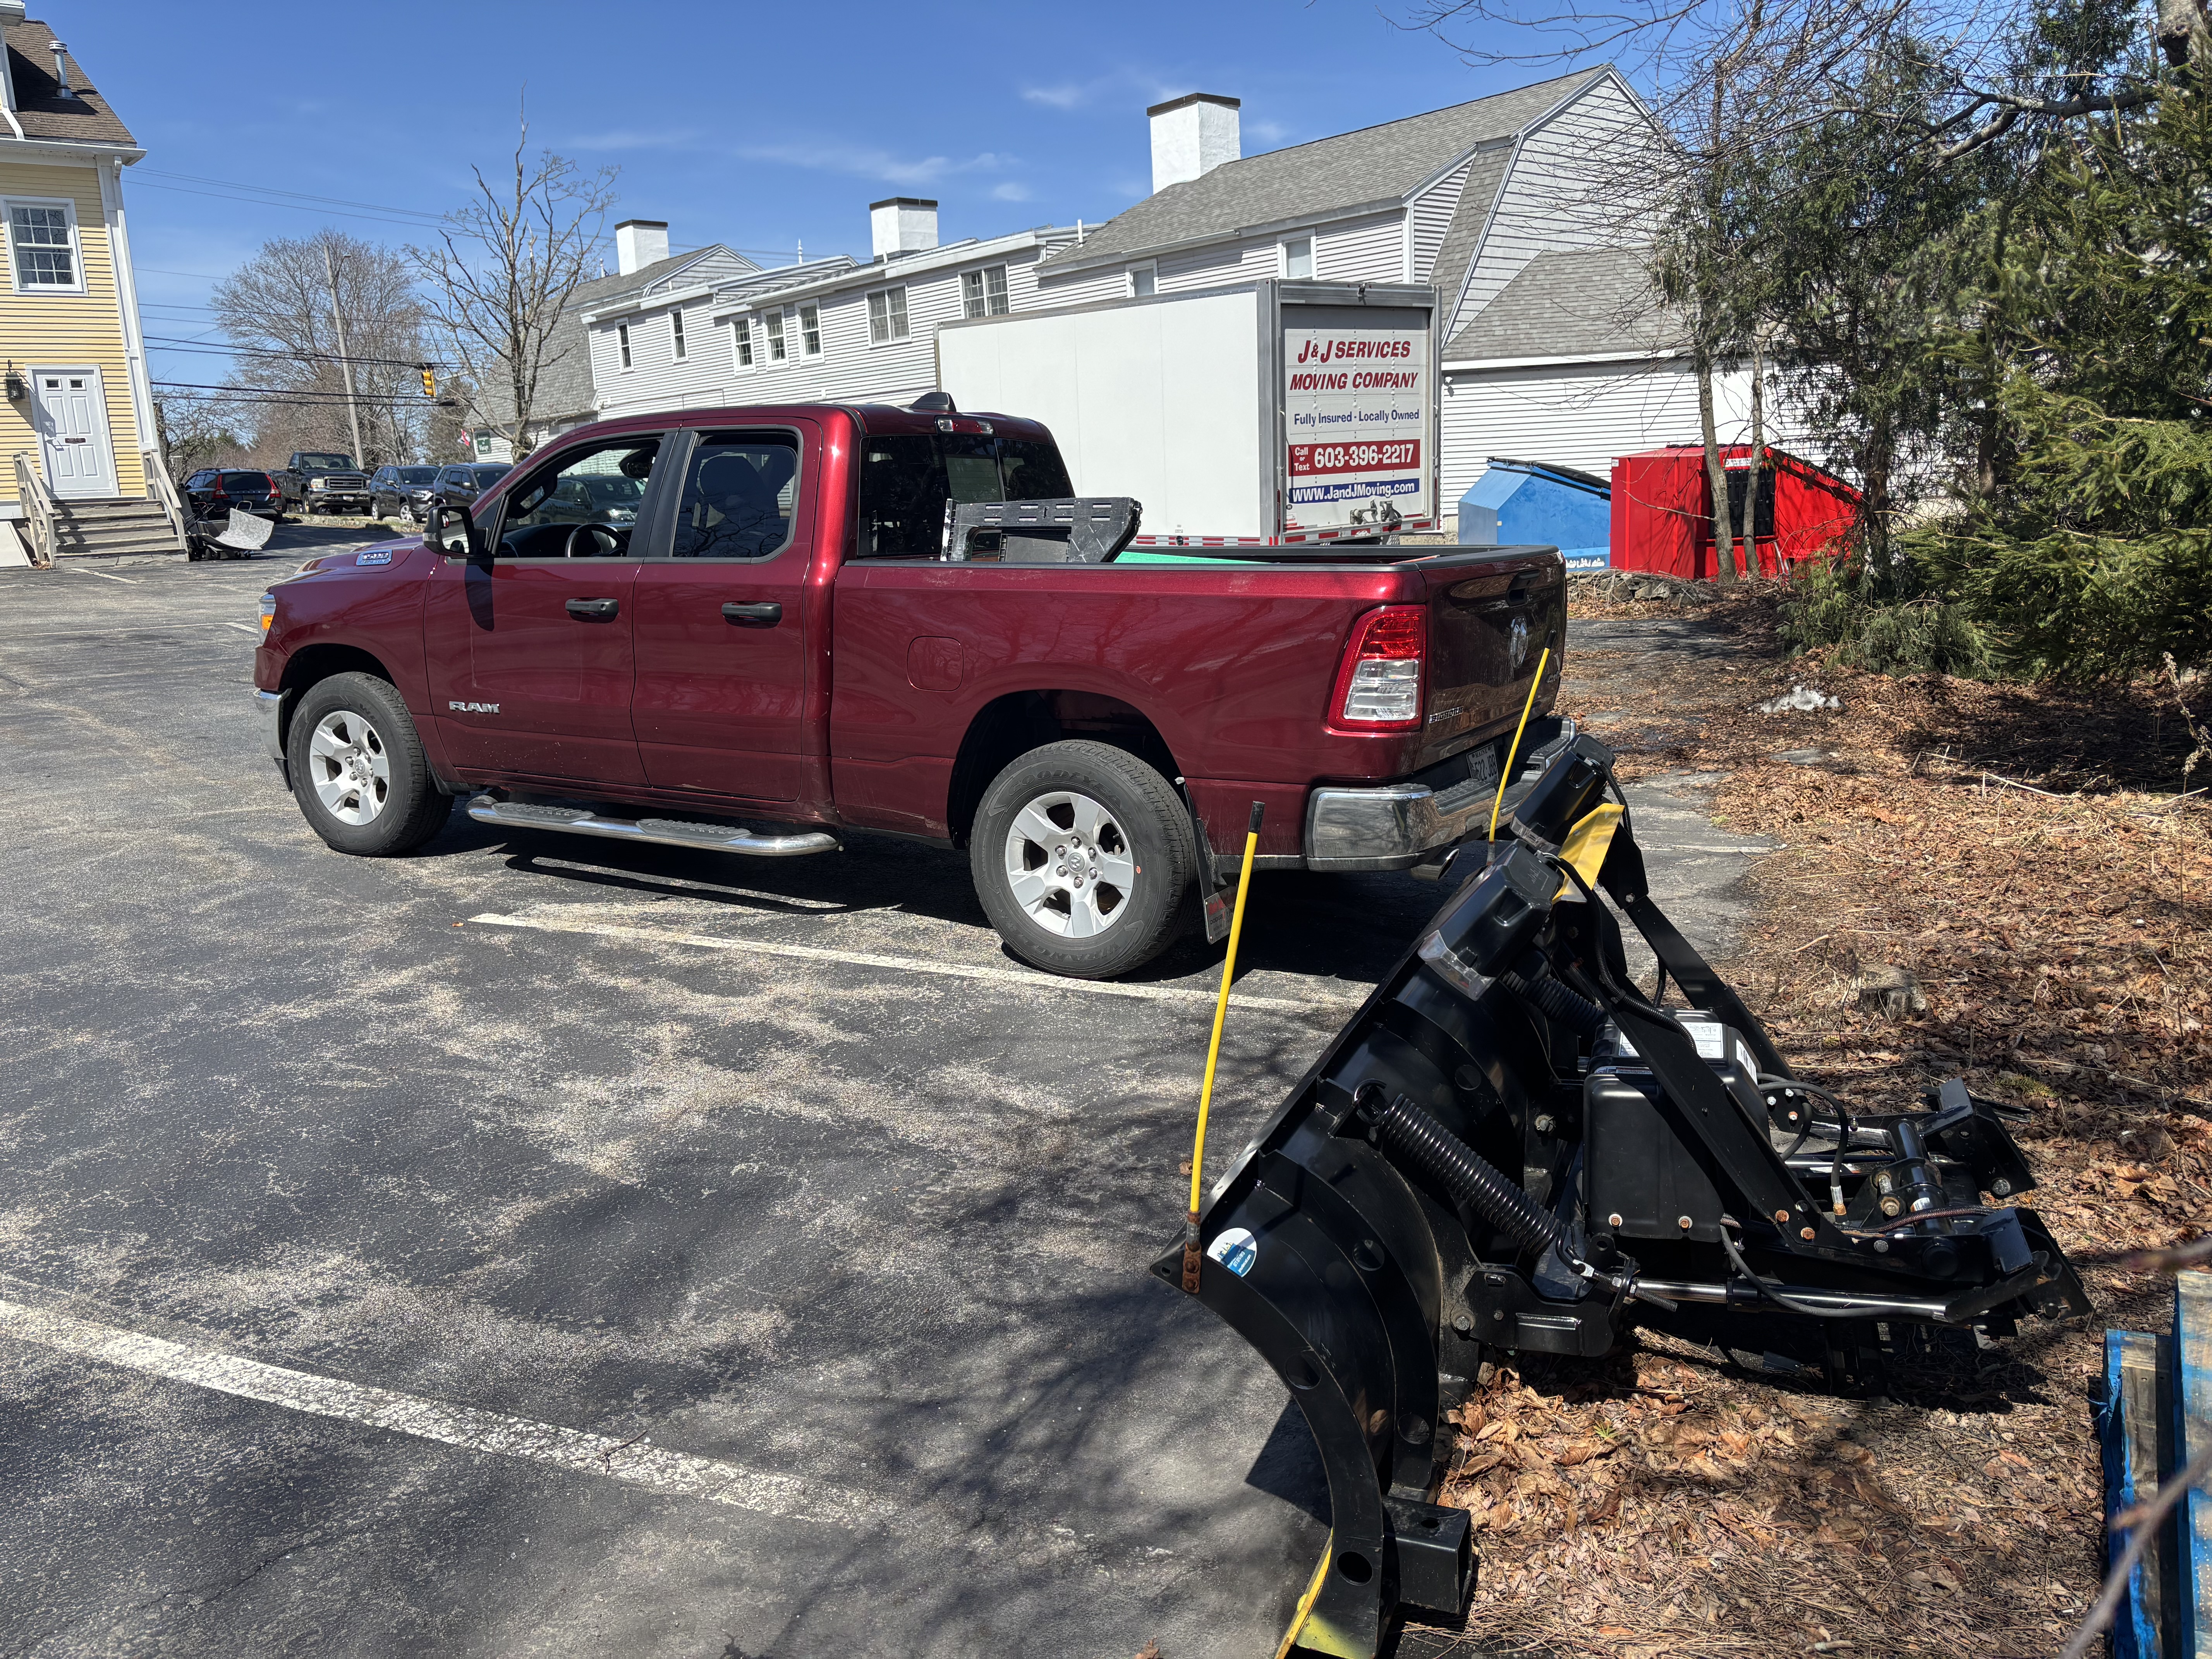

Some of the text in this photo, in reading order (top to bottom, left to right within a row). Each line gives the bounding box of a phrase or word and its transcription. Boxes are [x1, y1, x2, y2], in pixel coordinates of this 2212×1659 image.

[1335, 341, 1411, 359] SERVICES
[1290, 372, 1419, 390] MOVING COMPANY
[1295, 409, 1419, 427] Fully Insured Locally Owned
[1295, 447, 1309, 456] Call
[1314, 444, 1414, 468] 603-396-2217
[1294, 463, 1310, 471] Text
[1292, 483, 1415, 502] WWW.JandJMoving.com
[449, 701, 500, 714] RAM
[1475, 748, 1487, 758] MAINE
[1009, 769, 1135, 825] GOODYEAR
